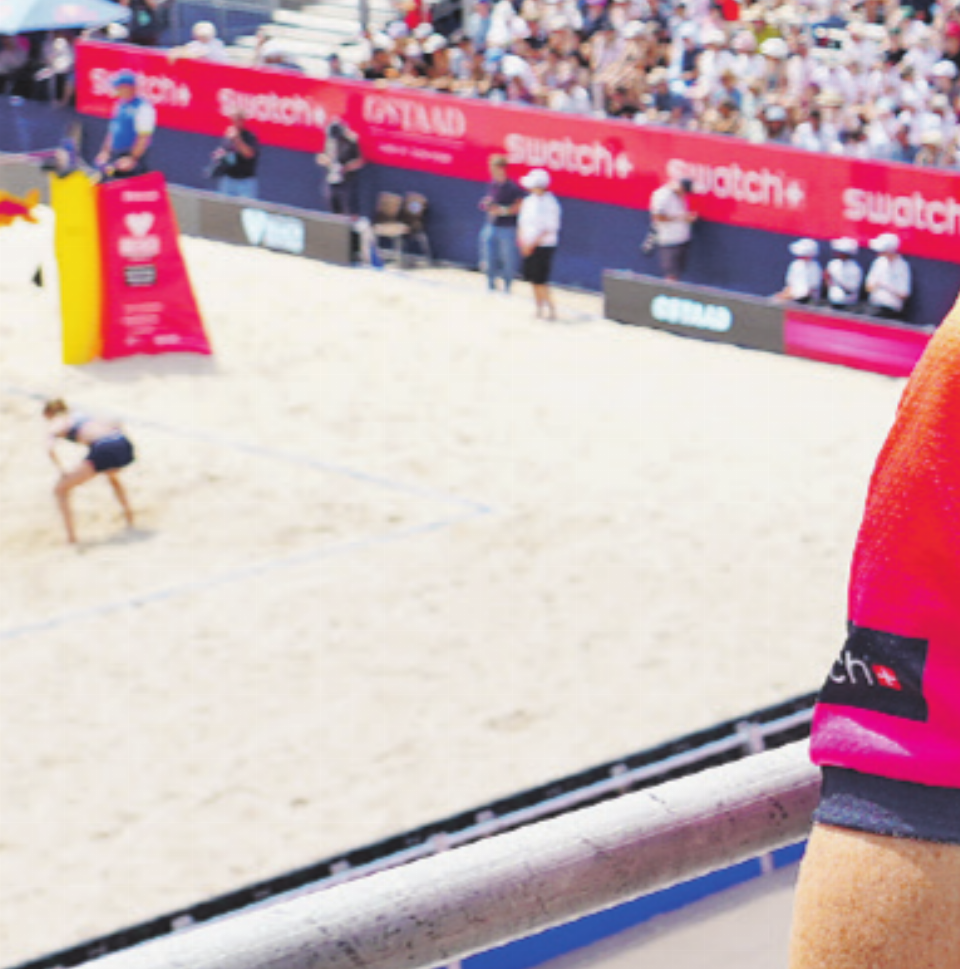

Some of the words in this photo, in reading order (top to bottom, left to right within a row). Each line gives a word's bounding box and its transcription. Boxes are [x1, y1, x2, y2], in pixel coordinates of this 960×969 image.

[217, 87, 313, 127] swatch
[362, 94, 467, 138] GSTAAD
[504, 132, 613, 177] swatch
[666, 157, 784, 206] swatch
